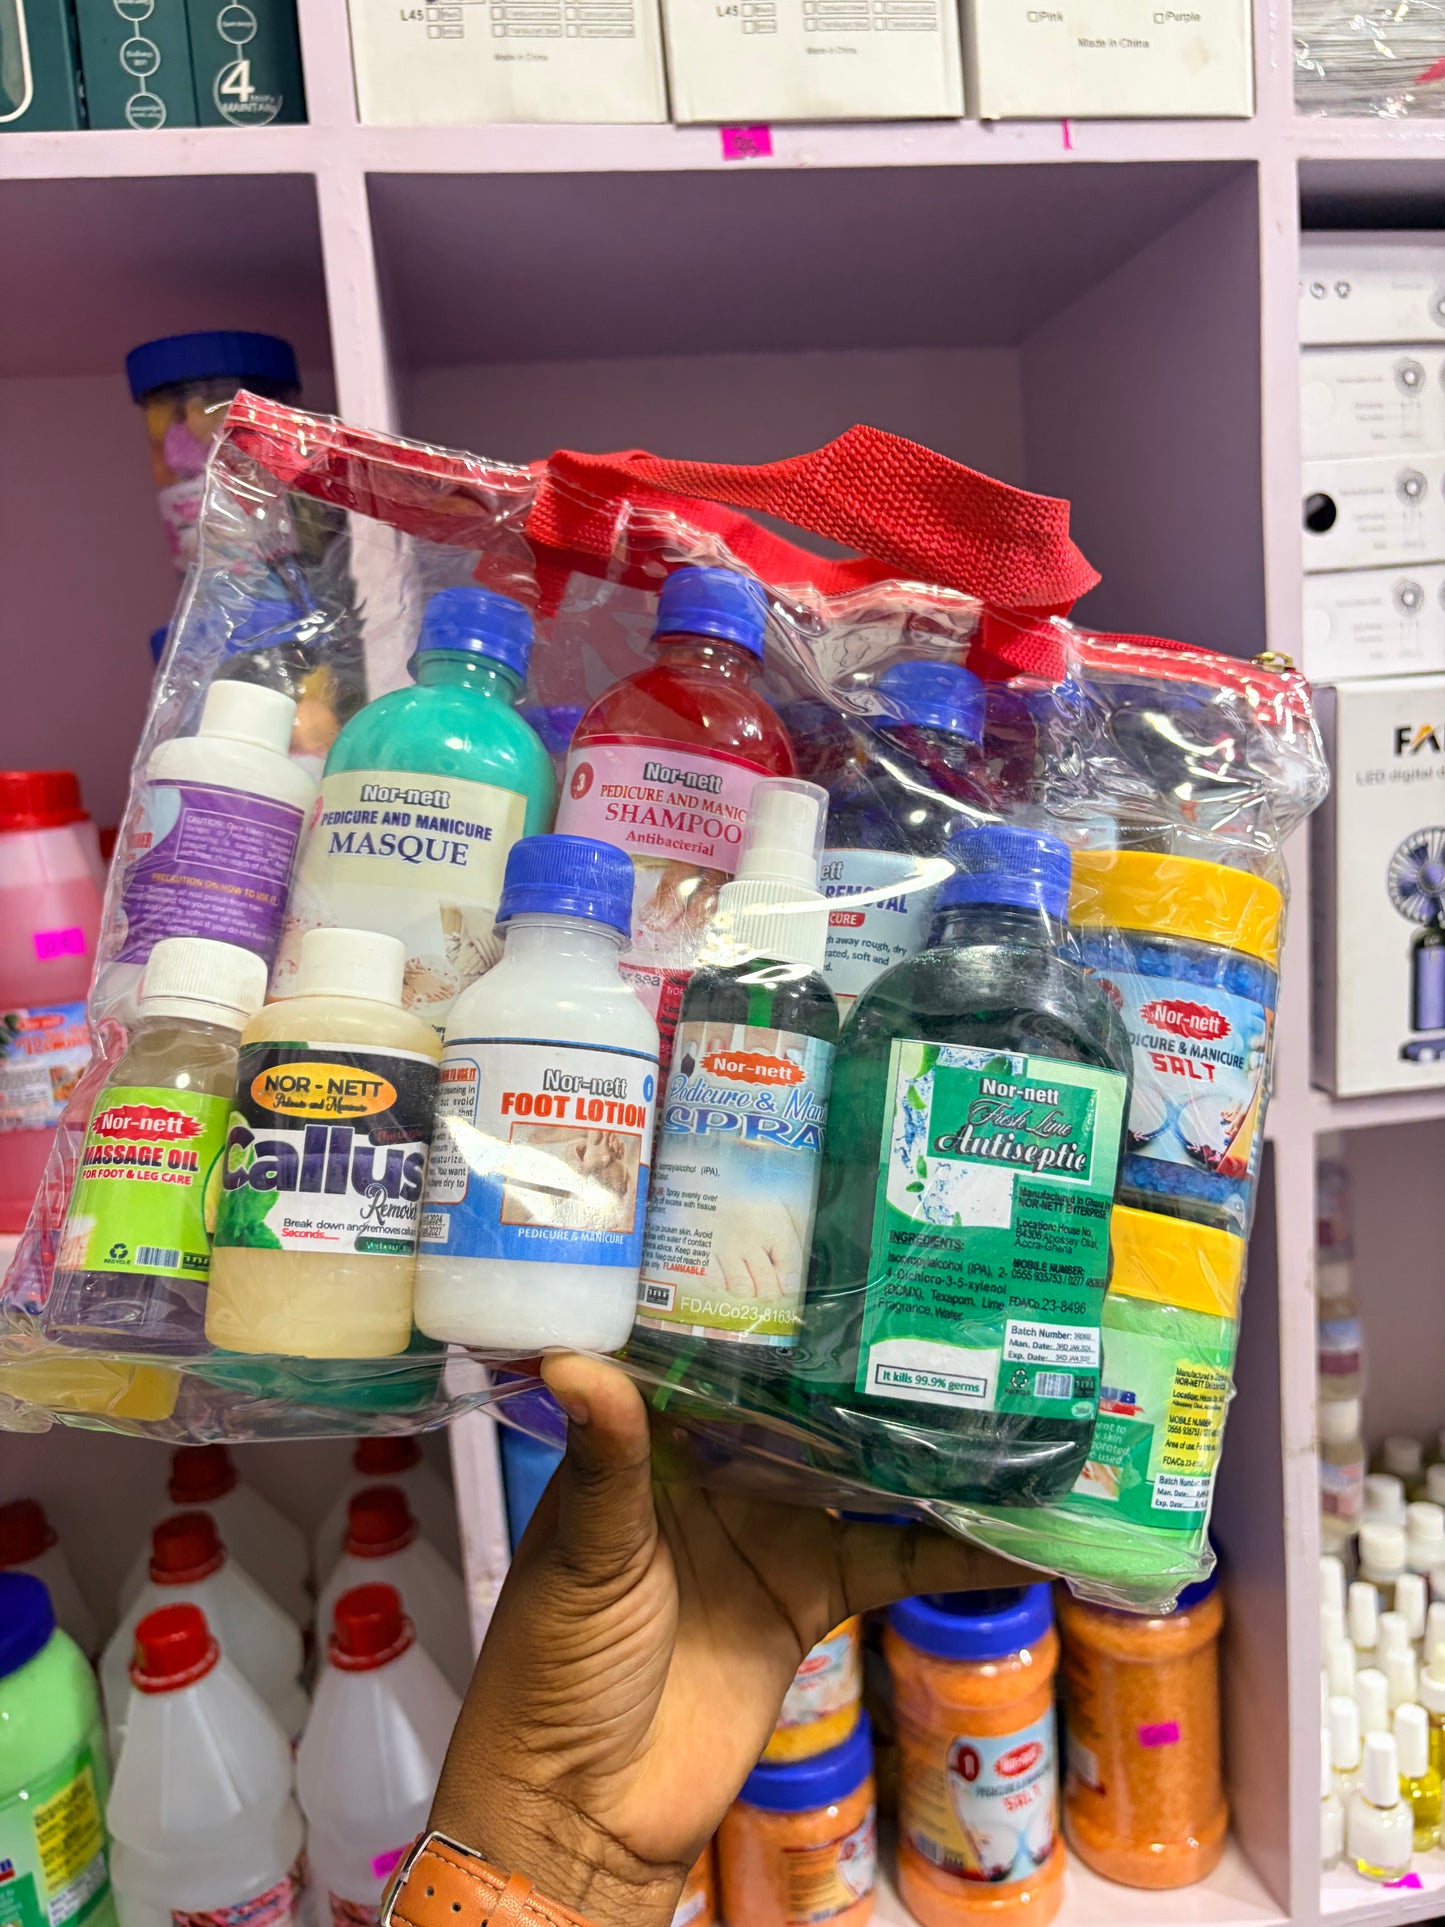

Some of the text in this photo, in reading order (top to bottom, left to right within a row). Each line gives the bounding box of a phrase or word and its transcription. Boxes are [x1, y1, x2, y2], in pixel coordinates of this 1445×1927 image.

[400, 10, 425, 22] L45
[1165, 12, 1200, 24] Purple
[1078, 38, 1106, 48] Made
[1119, 38, 1151, 48] China
[1393, 725, 1445, 758] FA
[576, 773, 586, 791] 3
[643, 762, 722, 794] Nor-nett
[1356, 768, 1433, 786] LED digital
[360, 784, 450, 809] Nor-nett
[600, 784, 664, 803] PEDICURE
[667, 792, 699, 809] AND
[320, 810, 492, 842] PEDICURE AND MANICURE
[605, 802, 742, 844] SHAMPOO
[328, 831, 469, 866] MASQUE
[625, 830, 714, 857] Antibacterial
[835, 937, 908, 957] away rough, dry
[852, 950, 871, 962] soft
[873, 956, 890, 966] and
[1153, 1004, 1221, 1034] Nor-nett
[1177, 1040, 1187, 1056] &
[1189, 1043, 1246, 1070] MANICURE
[712, 1057, 793, 1081] Nor-nett
[1148, 1051, 1216, 1082] SALT
[543, 1068, 627, 1099] Nor-nett
[980, 1078, 1059, 1105] Nor-nett
[453, 1096, 474, 1106] avoid
[669, 1073, 752, 1107] Pedicure
[754, 1091, 777, 1114] &
[500, 1092, 647, 1129] FOOT LOTION
[967, 1098, 1072, 1138] Fresh Lime
[101, 1113, 185, 1135] Nor-nett
[662, 1105, 826, 1153] SPRA
[934, 1123, 1087, 1173] Antiseptic
[82, 1144, 199, 1172] MASSAGE OIL
[82, 1168, 192, 1186] FOR FOOT & LEG CARE
[448, 1167, 466, 1176] want
[456, 1179, 465, 1188] to
[696, 1202, 716, 1212] tissue
[702, 1194, 718, 1202] over
[1018, 1197, 1064, 1212] NOR-NETT
[283, 1218, 313, 1229] Break
[316, 1219, 345, 1232] down
[366, 1223, 400, 1236] removes
[693, 1228, 713, 1239] Avoid
[1016, 1217, 1056, 1232] Location:
[1057, 1223, 1081, 1235] House
[517, 1228, 624, 1245] PEDICURE & MANICURE
[687, 1239, 712, 1248] contact
[890, 1230, 965, 1251] INGREDIENTS:
[674, 1246, 710, 1259] Keep away
[682, 1256, 701, 1266] reach
[701, 1259, 709, 1267] of
[1013, 1258, 1048, 1272] MOBILE
[981, 1296, 1005, 1311] Lime
[1011, 1325, 1037, 1337] Batch
[1039, 1328, 1072, 1340] Number:
[1009, 1338, 1030, 1349] Man.
[1008, 1350, 1025, 1360] Exp.
[882, 1370, 980, 1393] It kills 99.9% germs
[1103, 1432, 1122, 1443] skin
[1116, 1424, 1127, 1434] to
[1165, 1439, 1179, 1449] Area
[1179, 1440, 1186, 1449] of
[1098, 1453, 1124, 1465] used
[1158, 1475, 1178, 1485] Batch
[1156, 1488, 1172, 1497] Man.
[1155, 1499, 1168, 1507] Exp.
